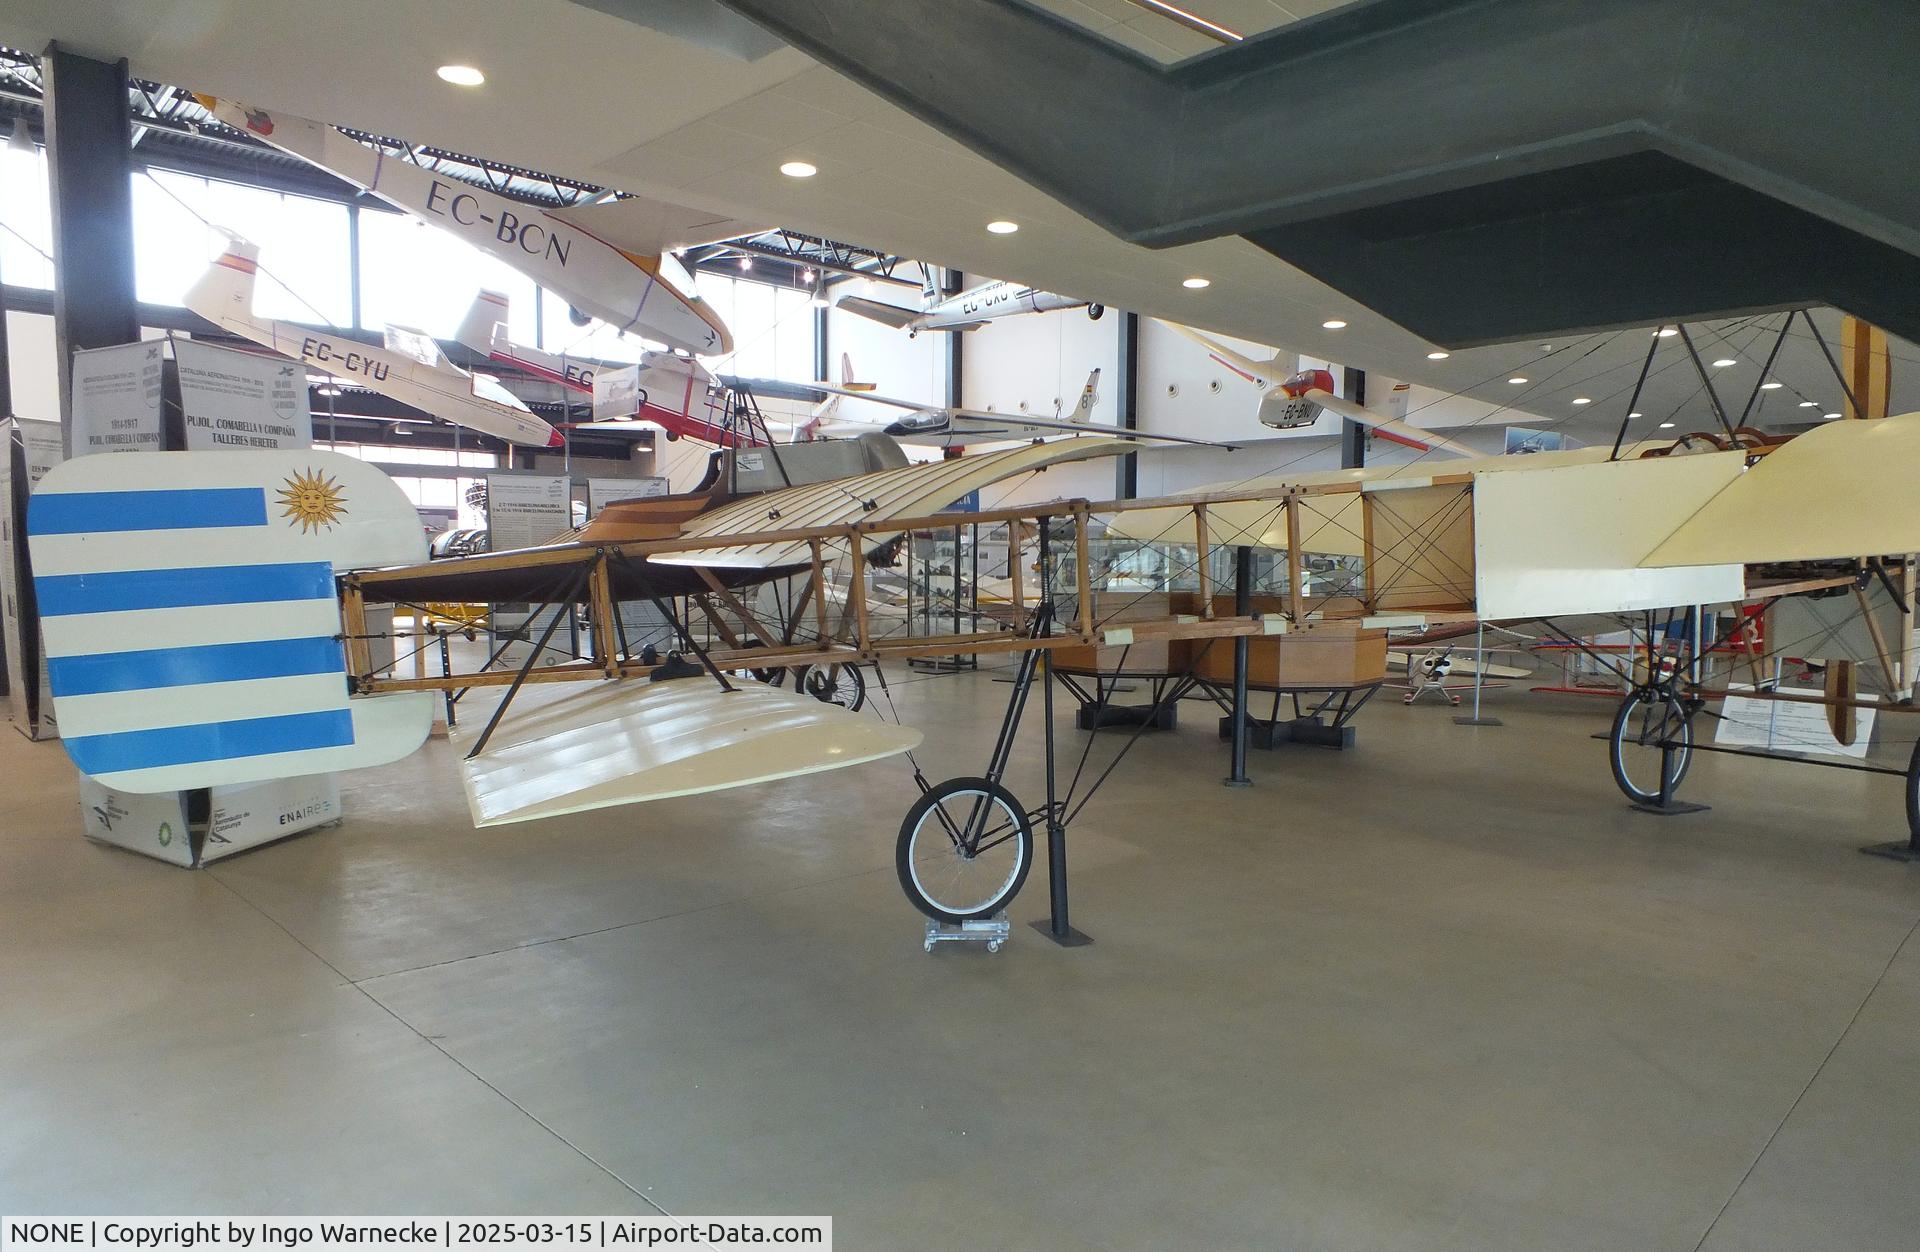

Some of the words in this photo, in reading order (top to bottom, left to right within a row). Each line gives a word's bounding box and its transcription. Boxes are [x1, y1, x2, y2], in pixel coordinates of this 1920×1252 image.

[427, 180, 571, 267] EC-BCN
[302, 337, 389, 381] EC-CYU
[187, 415, 214, 429] PUJOL,
[216, 418, 258, 433] COMABELLA
[212, 432, 249, 447] TALLERES
[250, 437, 278, 448] HERETER
